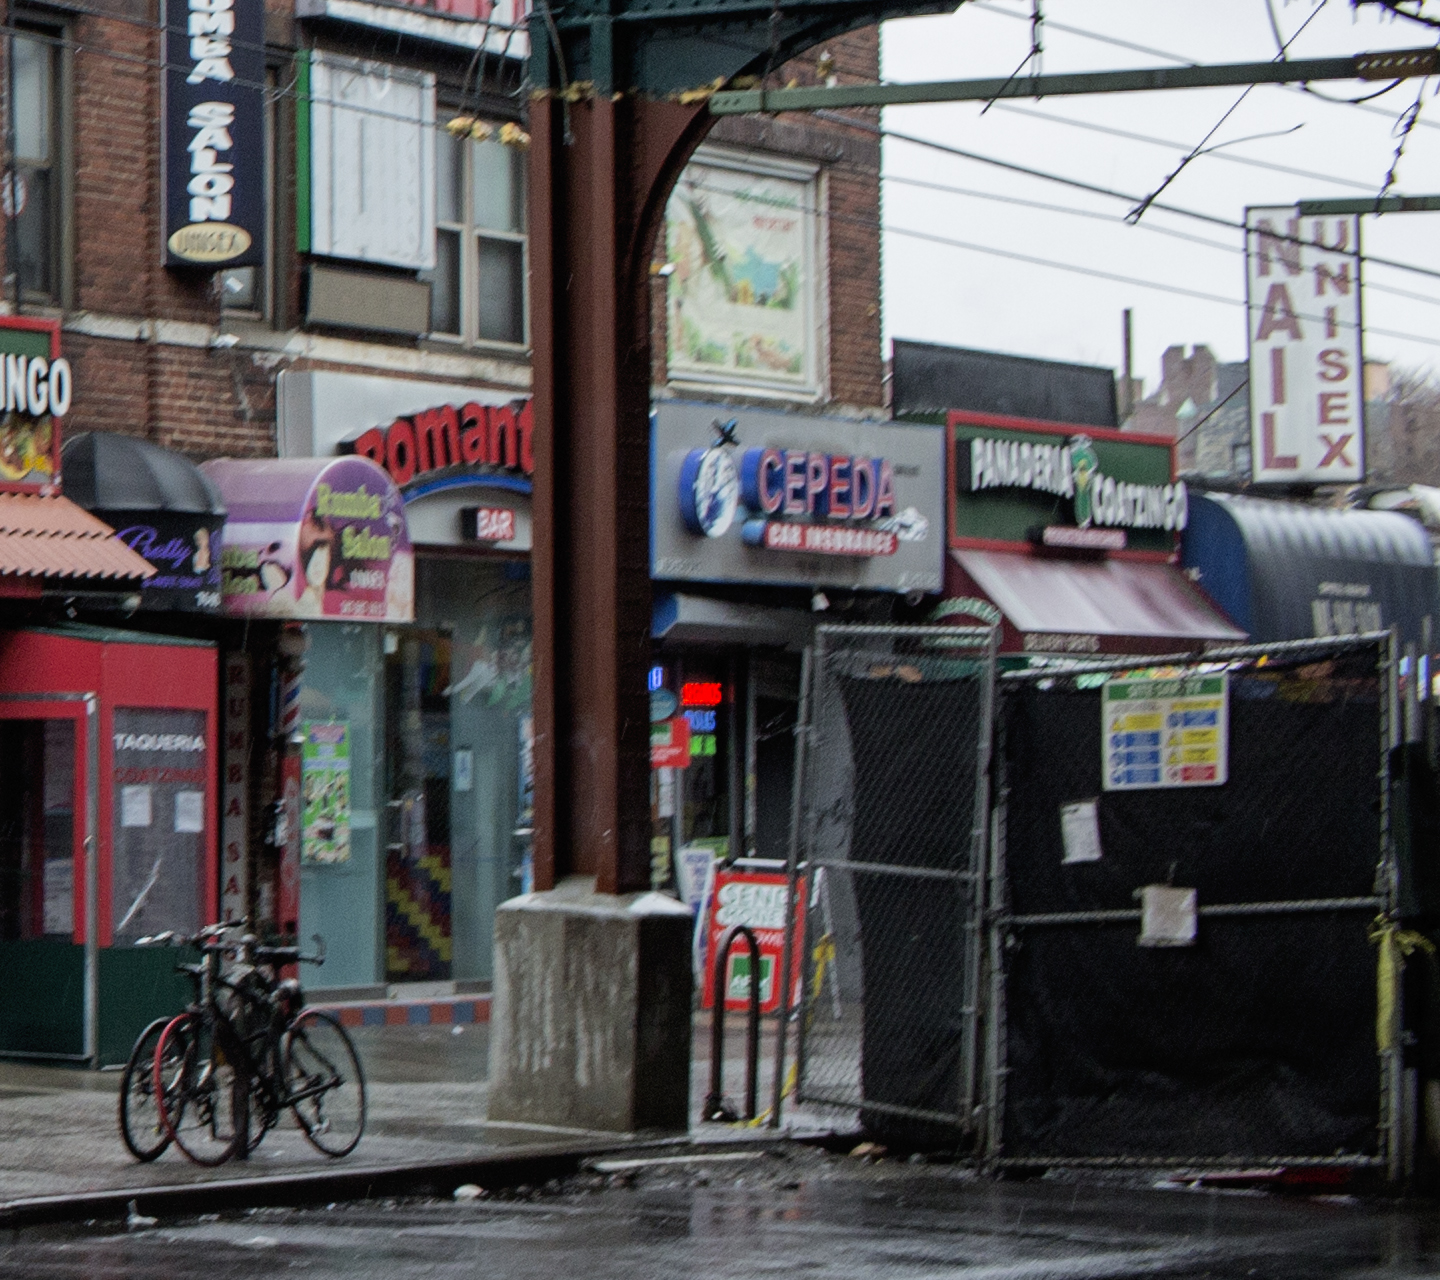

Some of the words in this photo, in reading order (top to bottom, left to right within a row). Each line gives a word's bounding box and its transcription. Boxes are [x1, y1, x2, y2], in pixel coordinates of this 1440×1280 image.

[187, 101, 235, 222] SALON
[1254, 217, 1304, 471] NAIL
[1314, 216, 1355, 469] UNISEX
[758, 448, 897, 521] CEPEDA
[1091, 473, 1188, 531] COATZINGO
[478, 508, 514, 540] BAR
[769, 524, 802, 547] CAR
[114, 731, 206, 752] TAQUERIA
